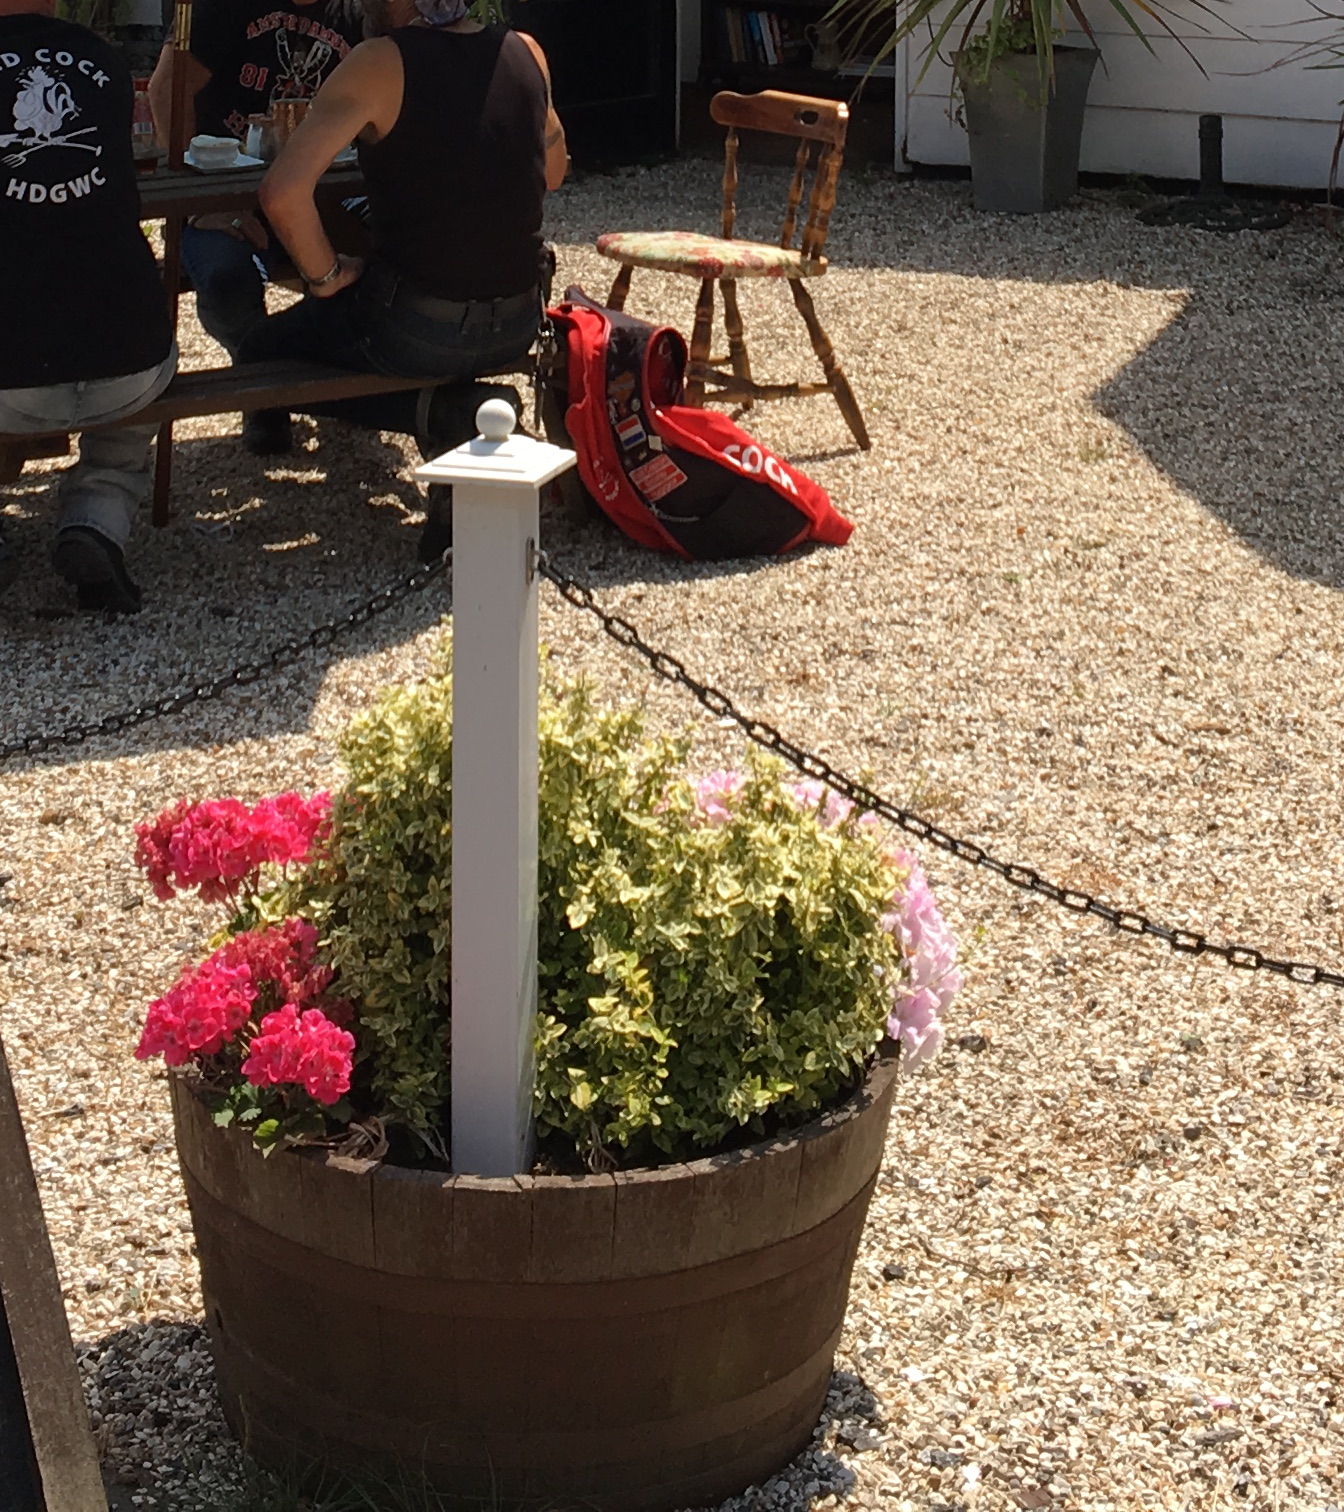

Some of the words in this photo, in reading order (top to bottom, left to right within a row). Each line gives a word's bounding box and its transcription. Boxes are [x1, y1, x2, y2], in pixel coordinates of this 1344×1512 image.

[35, 48, 110, 88] COCK
[239, 63, 269, 91] 81
[5, 167, 107, 203] HDGWC
[722, 444, 798, 496] COCK
